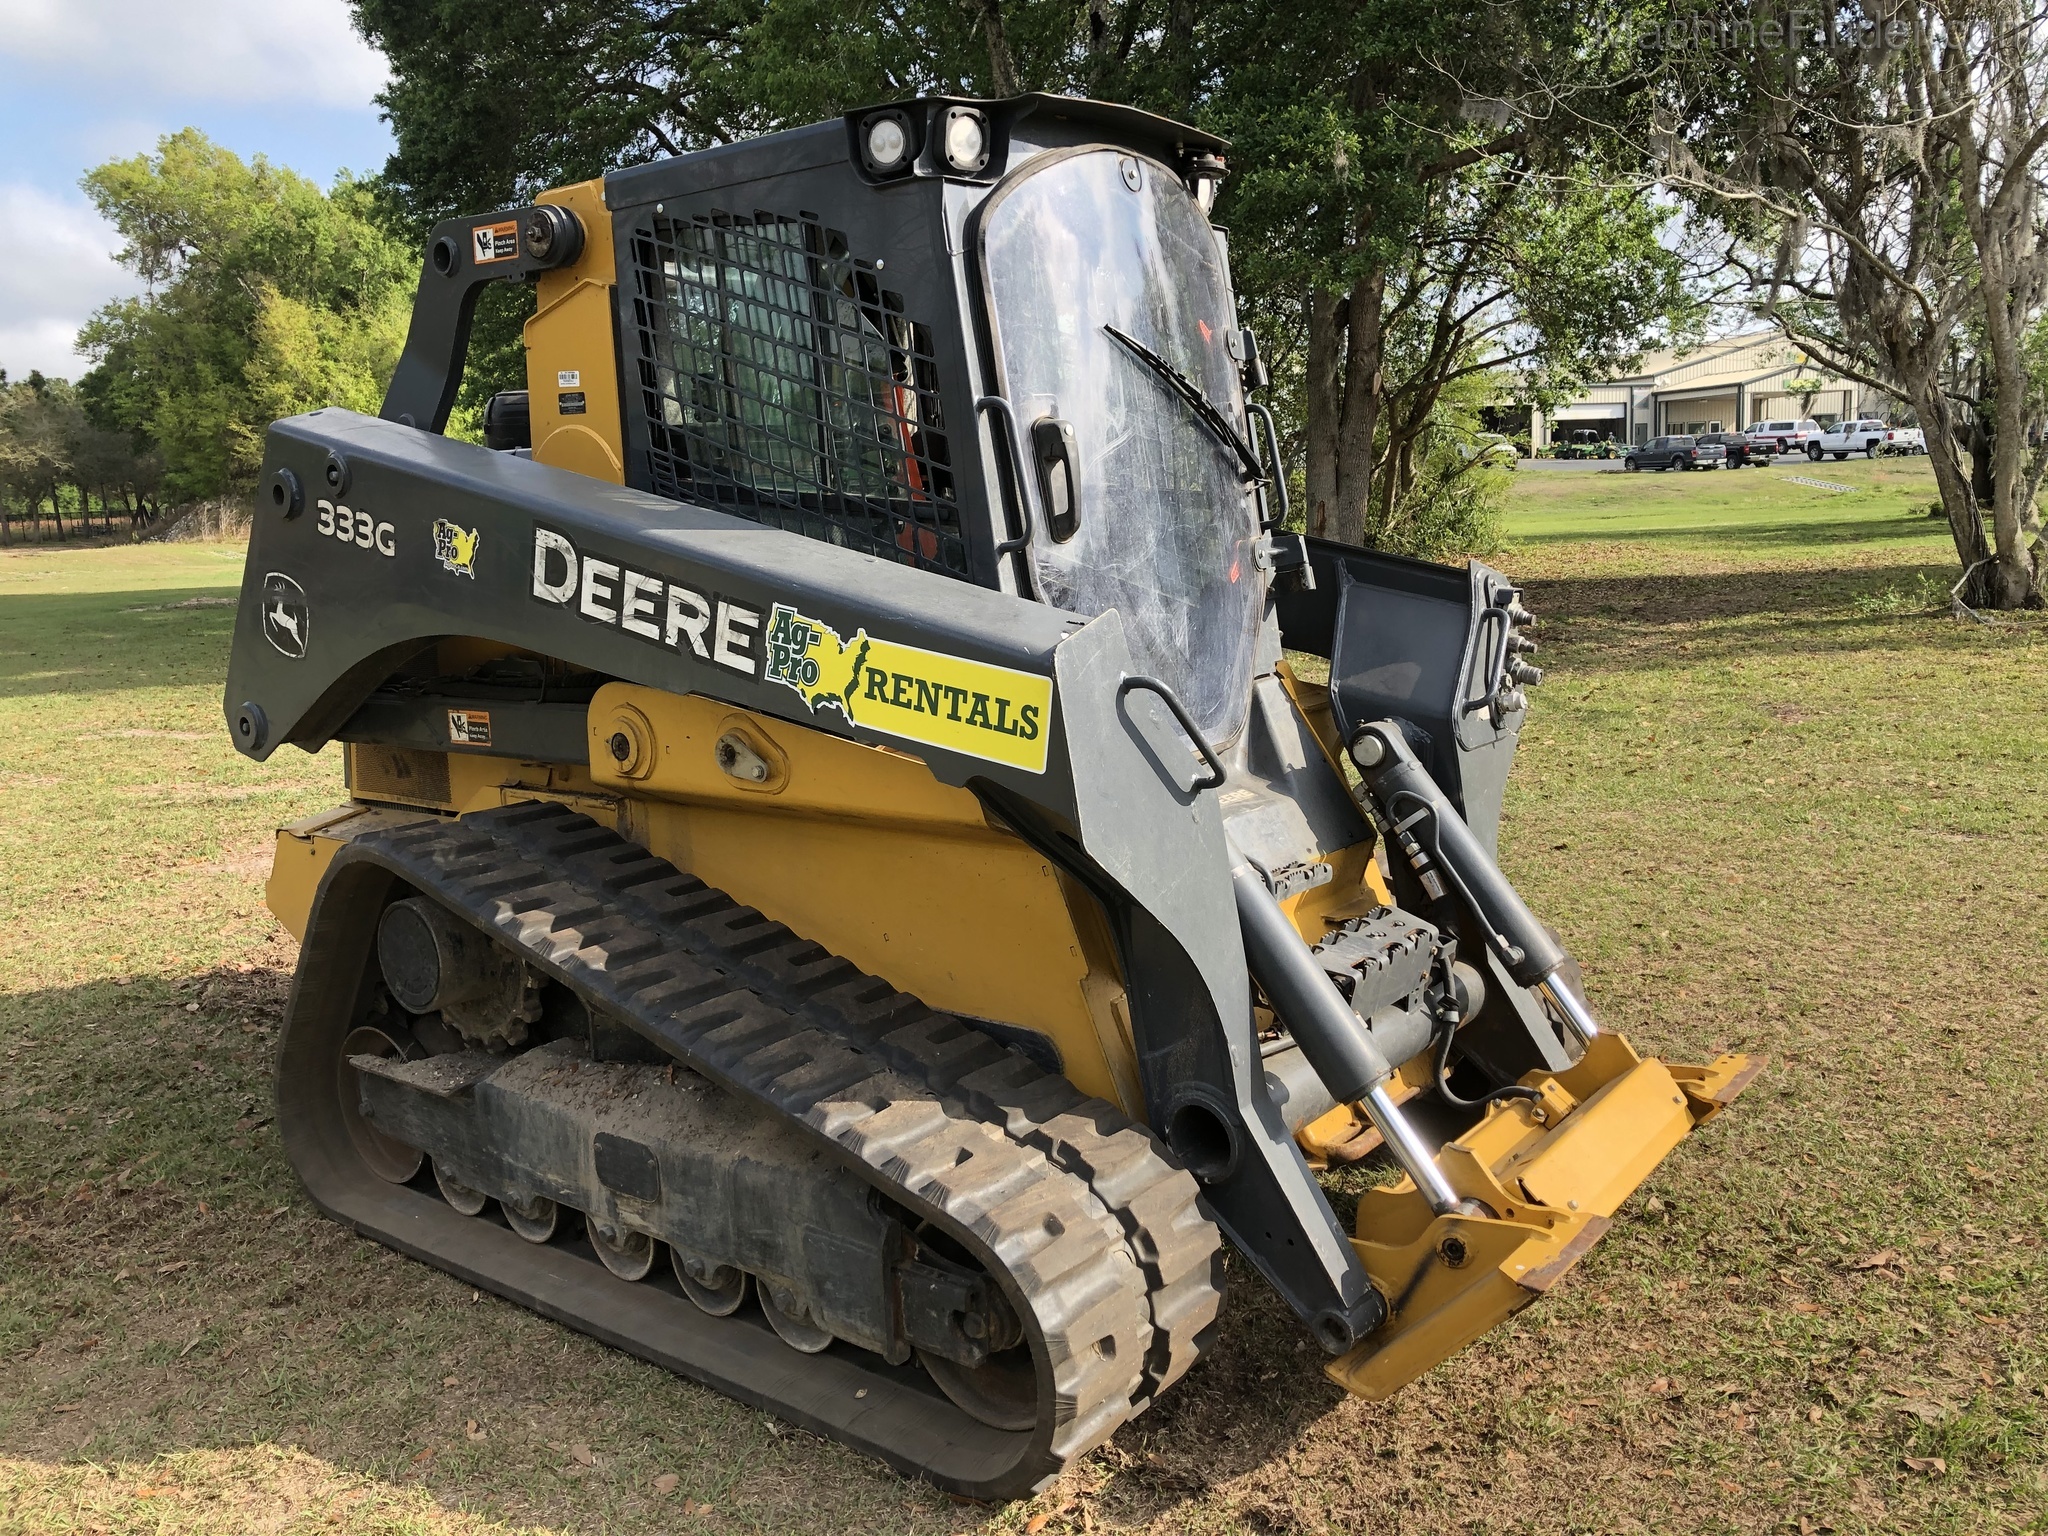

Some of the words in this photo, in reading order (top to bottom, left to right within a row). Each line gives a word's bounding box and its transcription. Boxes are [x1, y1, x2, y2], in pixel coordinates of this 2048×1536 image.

[317, 499, 396, 557] 333G
[438, 523, 457, 543] Ag-
[438, 539, 458, 558] Pro
[533, 527, 759, 675] DEERE
[771, 611, 820, 654] Ag-
[770, 646, 818, 684] Pro
[864, 667, 1039, 740] RENTALS
